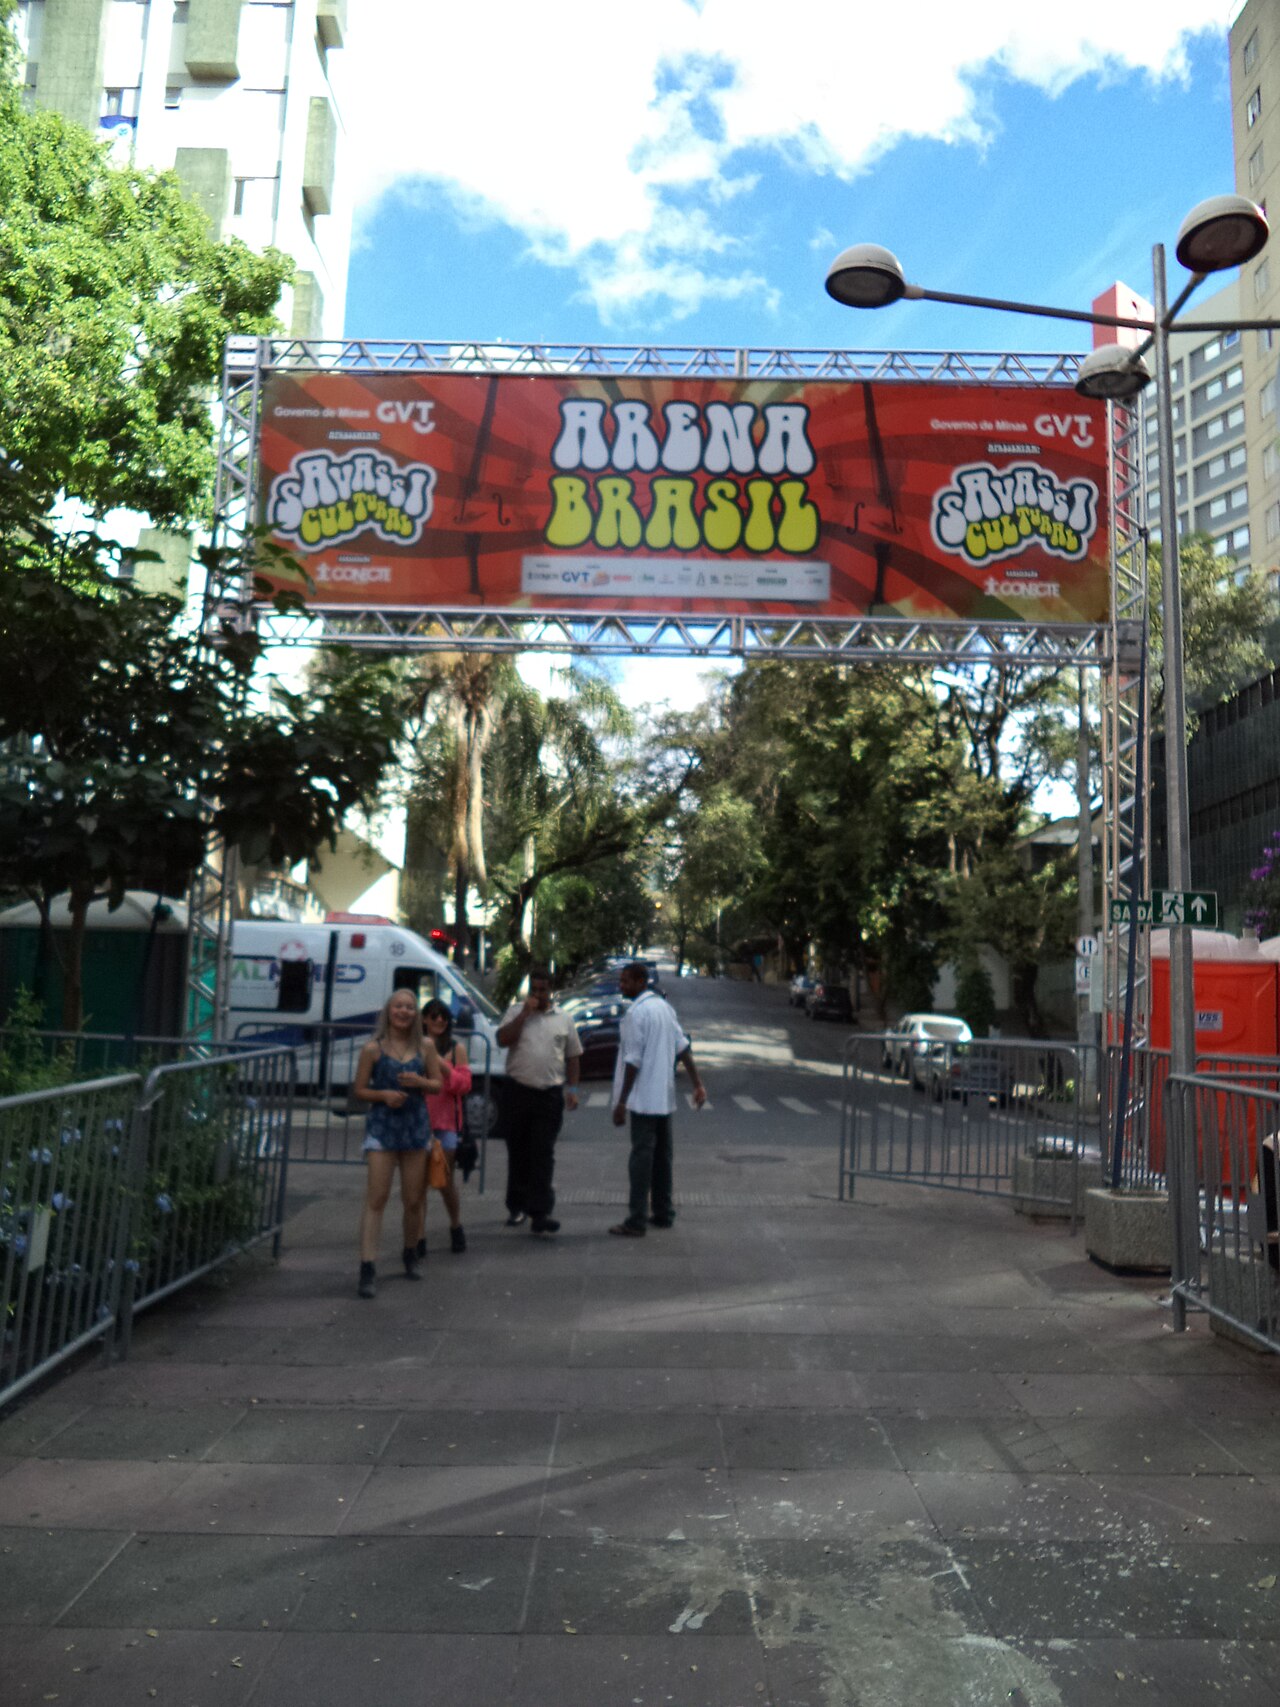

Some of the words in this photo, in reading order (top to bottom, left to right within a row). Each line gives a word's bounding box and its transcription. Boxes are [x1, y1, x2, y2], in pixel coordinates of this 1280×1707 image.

[376, 400, 435, 425] GVT
[552, 400, 815, 475] ARENA
[1034, 415, 1092, 437] GVT
[276, 454, 428, 530] SAVASSI
[301, 491, 413, 543] CULTURAL
[546, 475, 819, 551] BRASIL
[940, 469, 1090, 544] SAVASSI
[966, 506, 1079, 557] CULTURAL
[561, 571, 590, 583] GVT
[1112, 905, 1153, 921] SADA
